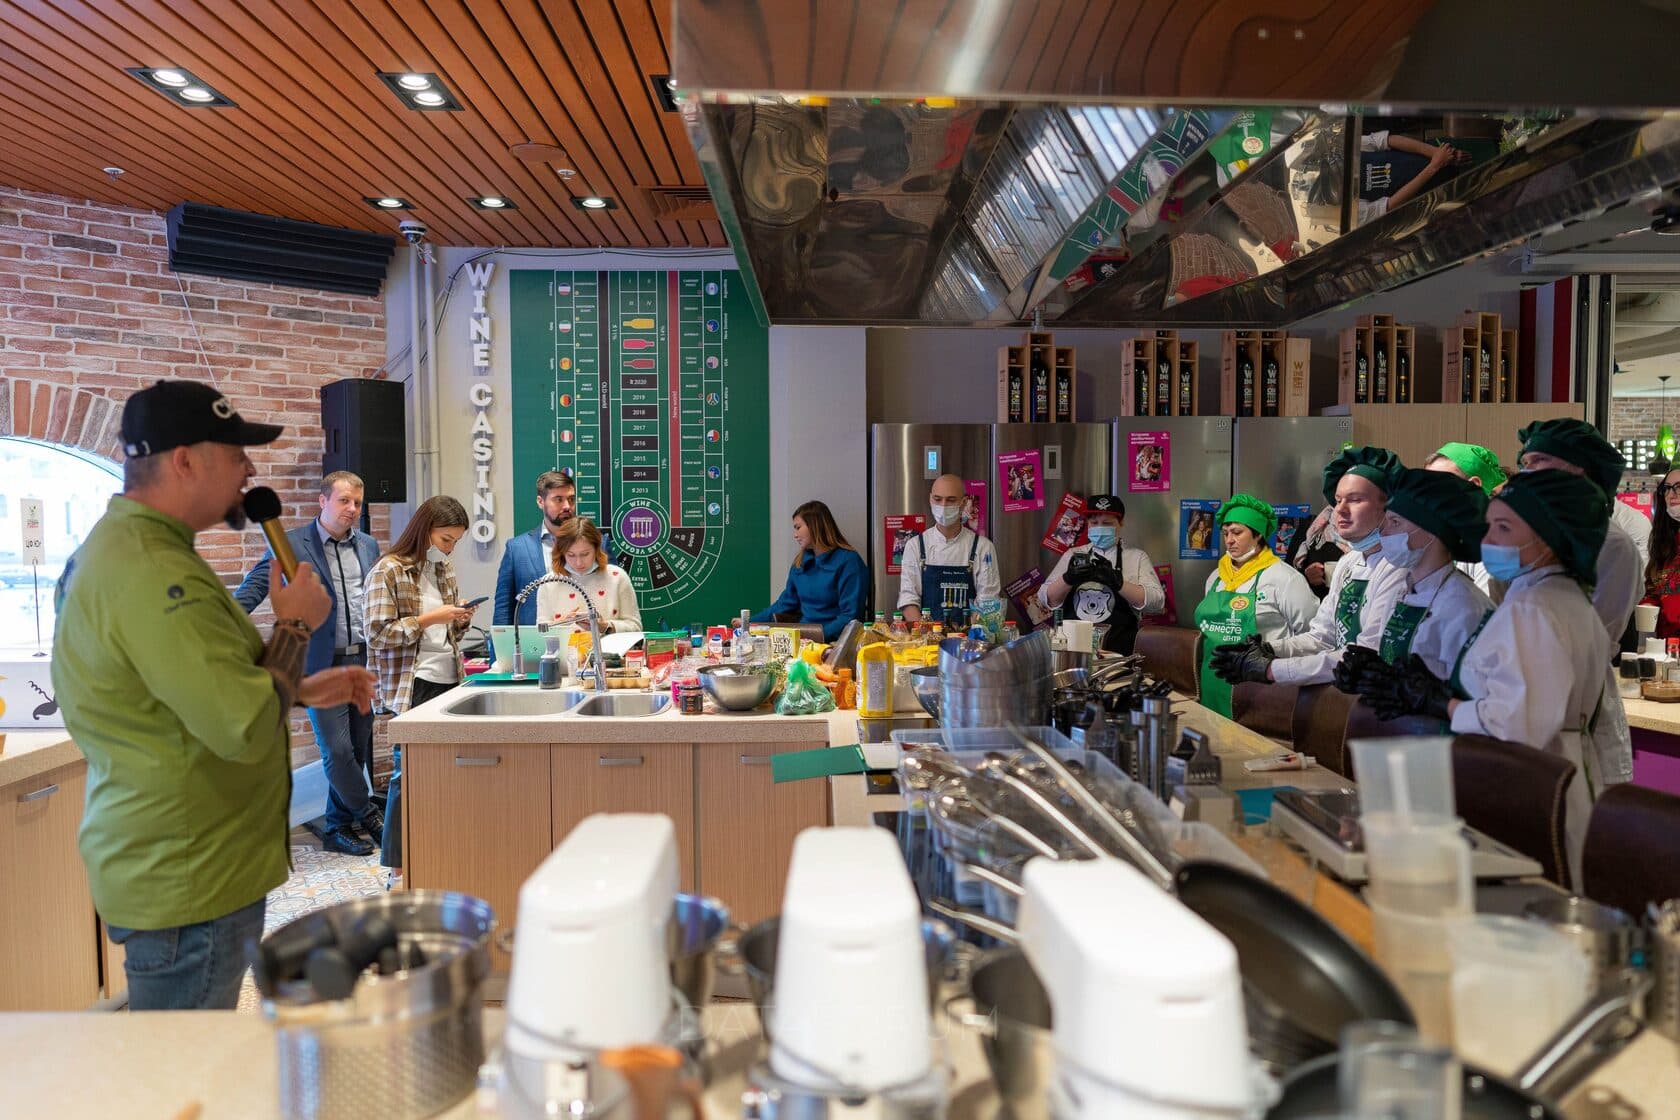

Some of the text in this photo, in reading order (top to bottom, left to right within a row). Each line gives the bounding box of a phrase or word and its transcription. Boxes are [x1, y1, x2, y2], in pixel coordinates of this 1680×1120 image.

[464, 262, 496, 544] WINE CASINO
[629, 500, 651, 508] WINE
[620, 540, 646, 555] VEGAS
